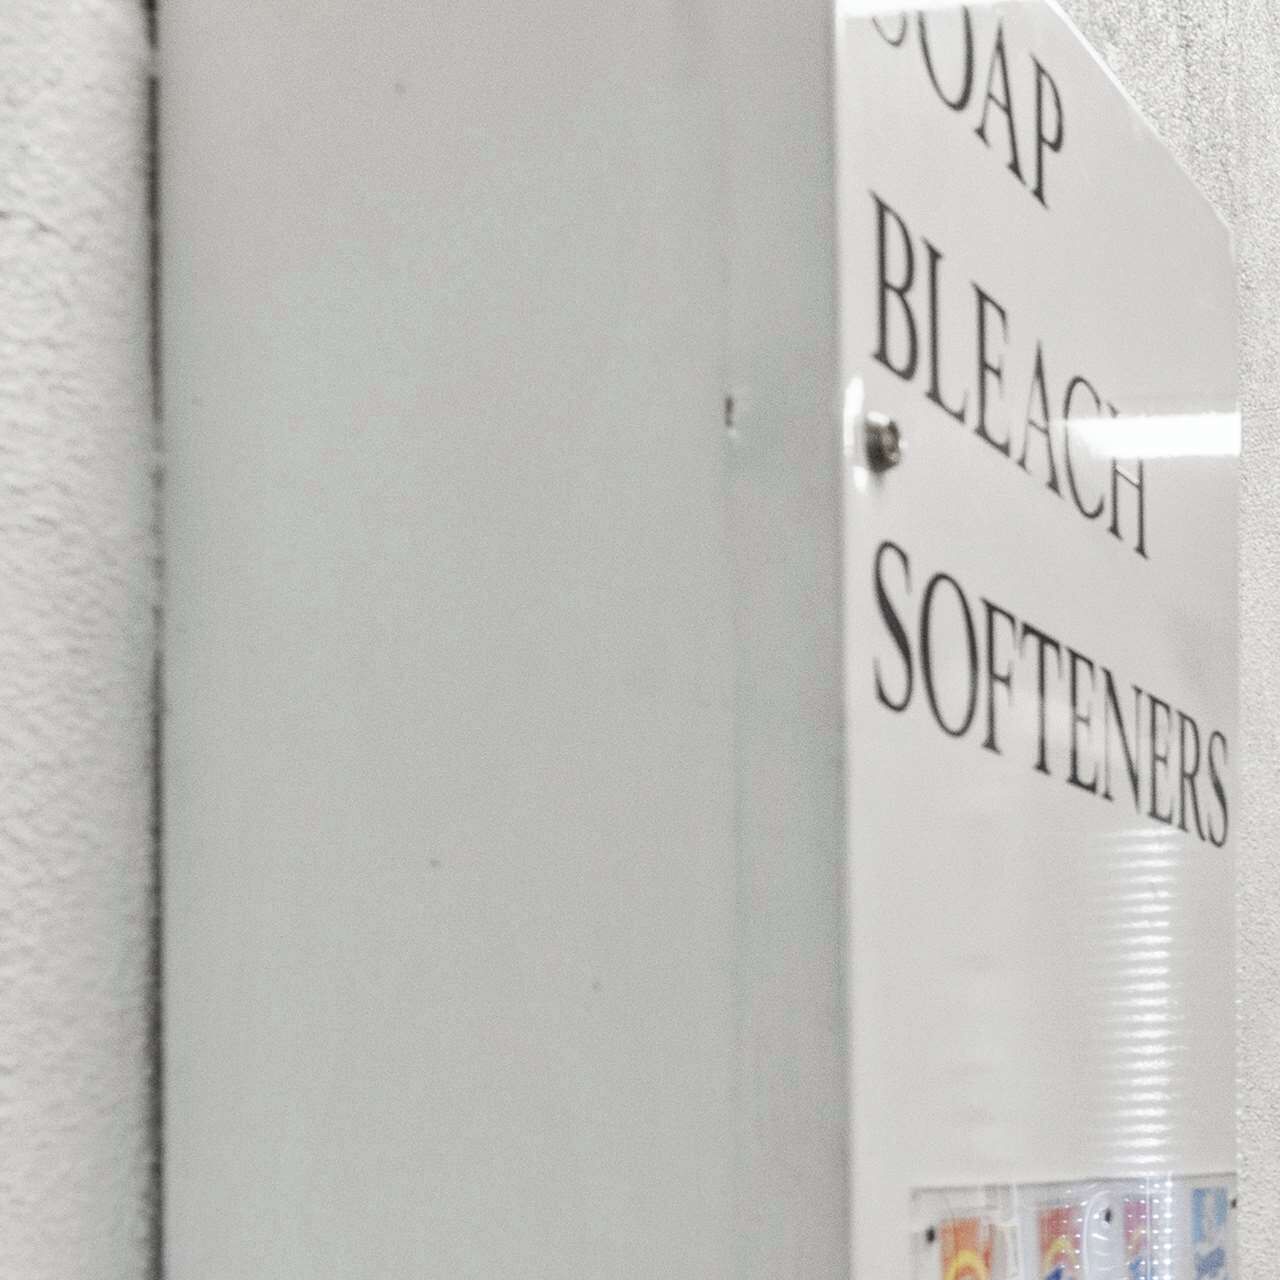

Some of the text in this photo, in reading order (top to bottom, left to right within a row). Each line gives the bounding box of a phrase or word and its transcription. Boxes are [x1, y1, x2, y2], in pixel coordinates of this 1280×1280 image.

[871, 6, 1064, 209] OAP
[869, 189, 1150, 560] BLEACH
[873, 540, 1230, 848] SOFTENERS
